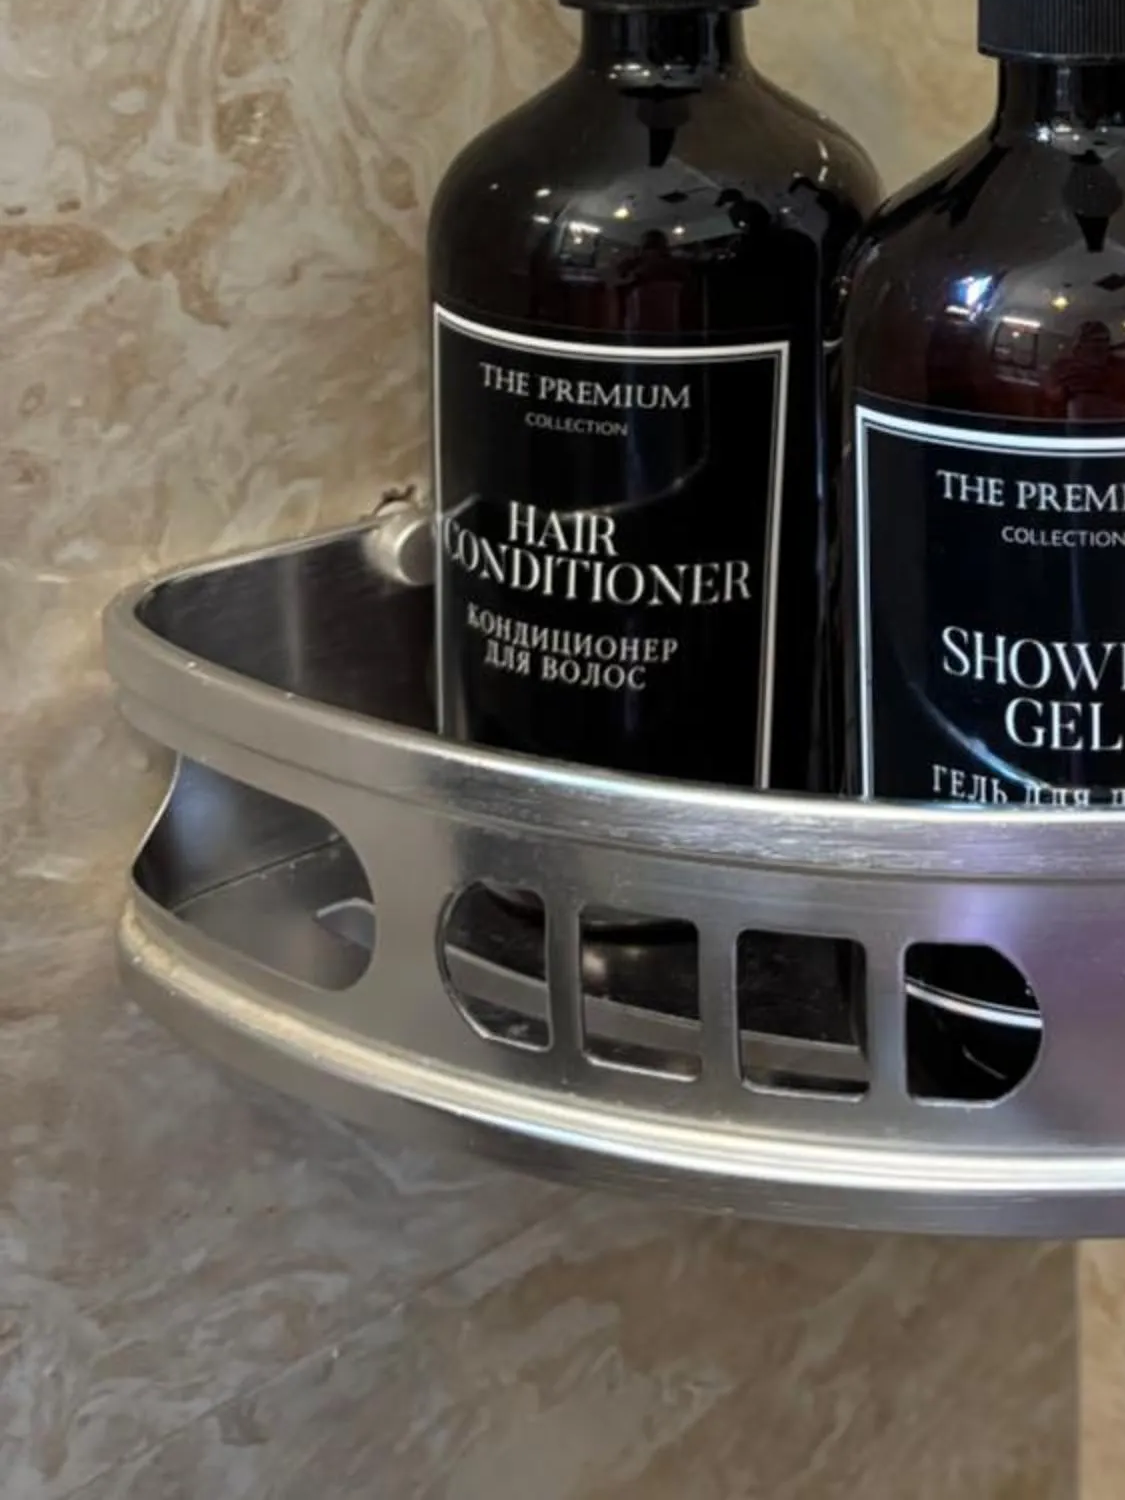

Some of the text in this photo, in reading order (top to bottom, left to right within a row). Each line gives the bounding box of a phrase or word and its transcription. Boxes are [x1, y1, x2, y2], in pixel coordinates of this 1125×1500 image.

[479, 362, 692, 410] THE PREMIUM
[525, 411, 629, 437] COLLECTION
[936, 469, 1005, 507] THE
[508, 501, 620, 557] HAIR
[443, 516, 752, 607] CONDITIONER
[466, 601, 679, 664] КОНДИЦИОНЕР
[484, 640, 647, 690] ДЛЯ ВОЛОС
[1005, 697, 1124, 752] GEL
[932, 764, 1008, 805] ГЕЛЬ
